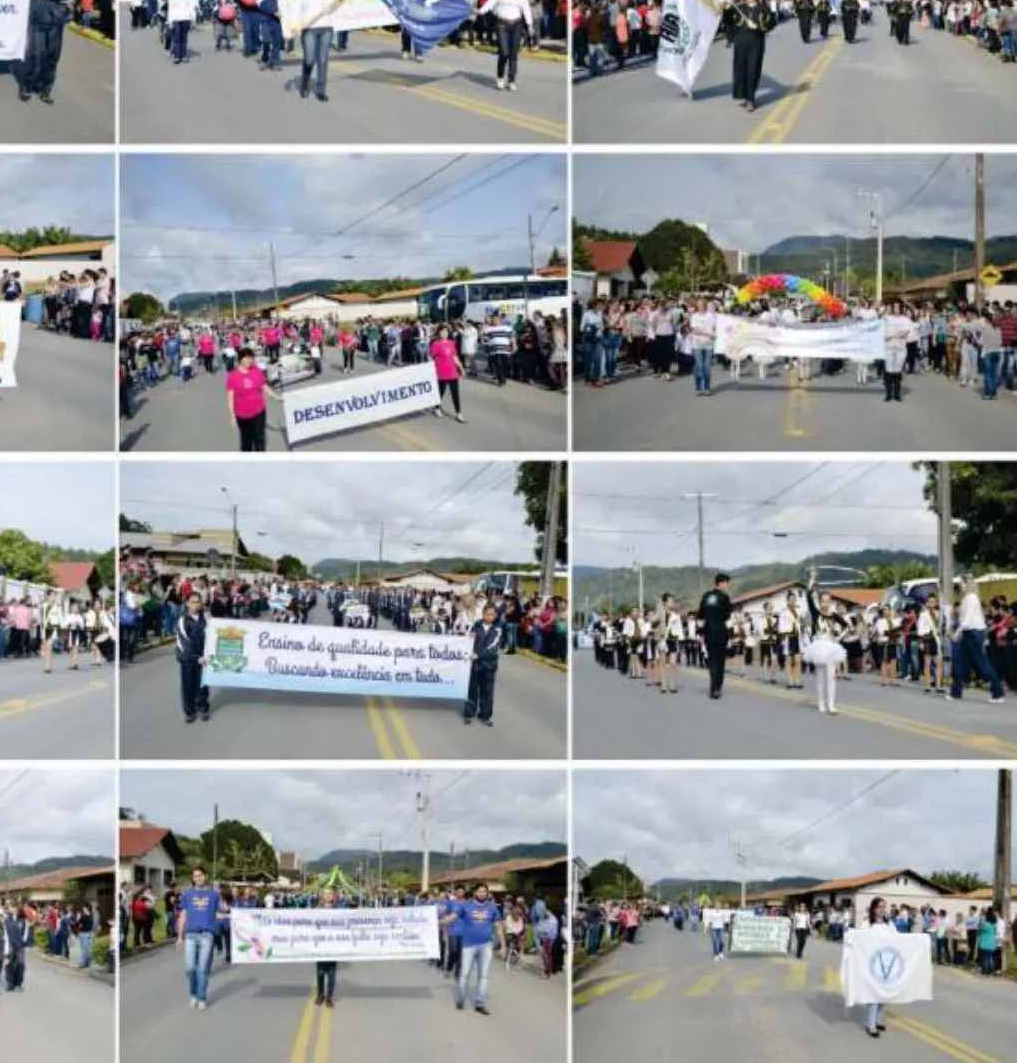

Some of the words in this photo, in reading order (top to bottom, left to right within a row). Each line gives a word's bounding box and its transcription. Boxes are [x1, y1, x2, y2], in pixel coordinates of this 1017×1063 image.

[293, 381, 432, 424] DESENVOLVIMENTO
[258, 631, 305, 650] Ensino
[308, 636, 325, 652] de
[327, 639, 391, 661] qualidade
[394, 646, 426, 665] para
